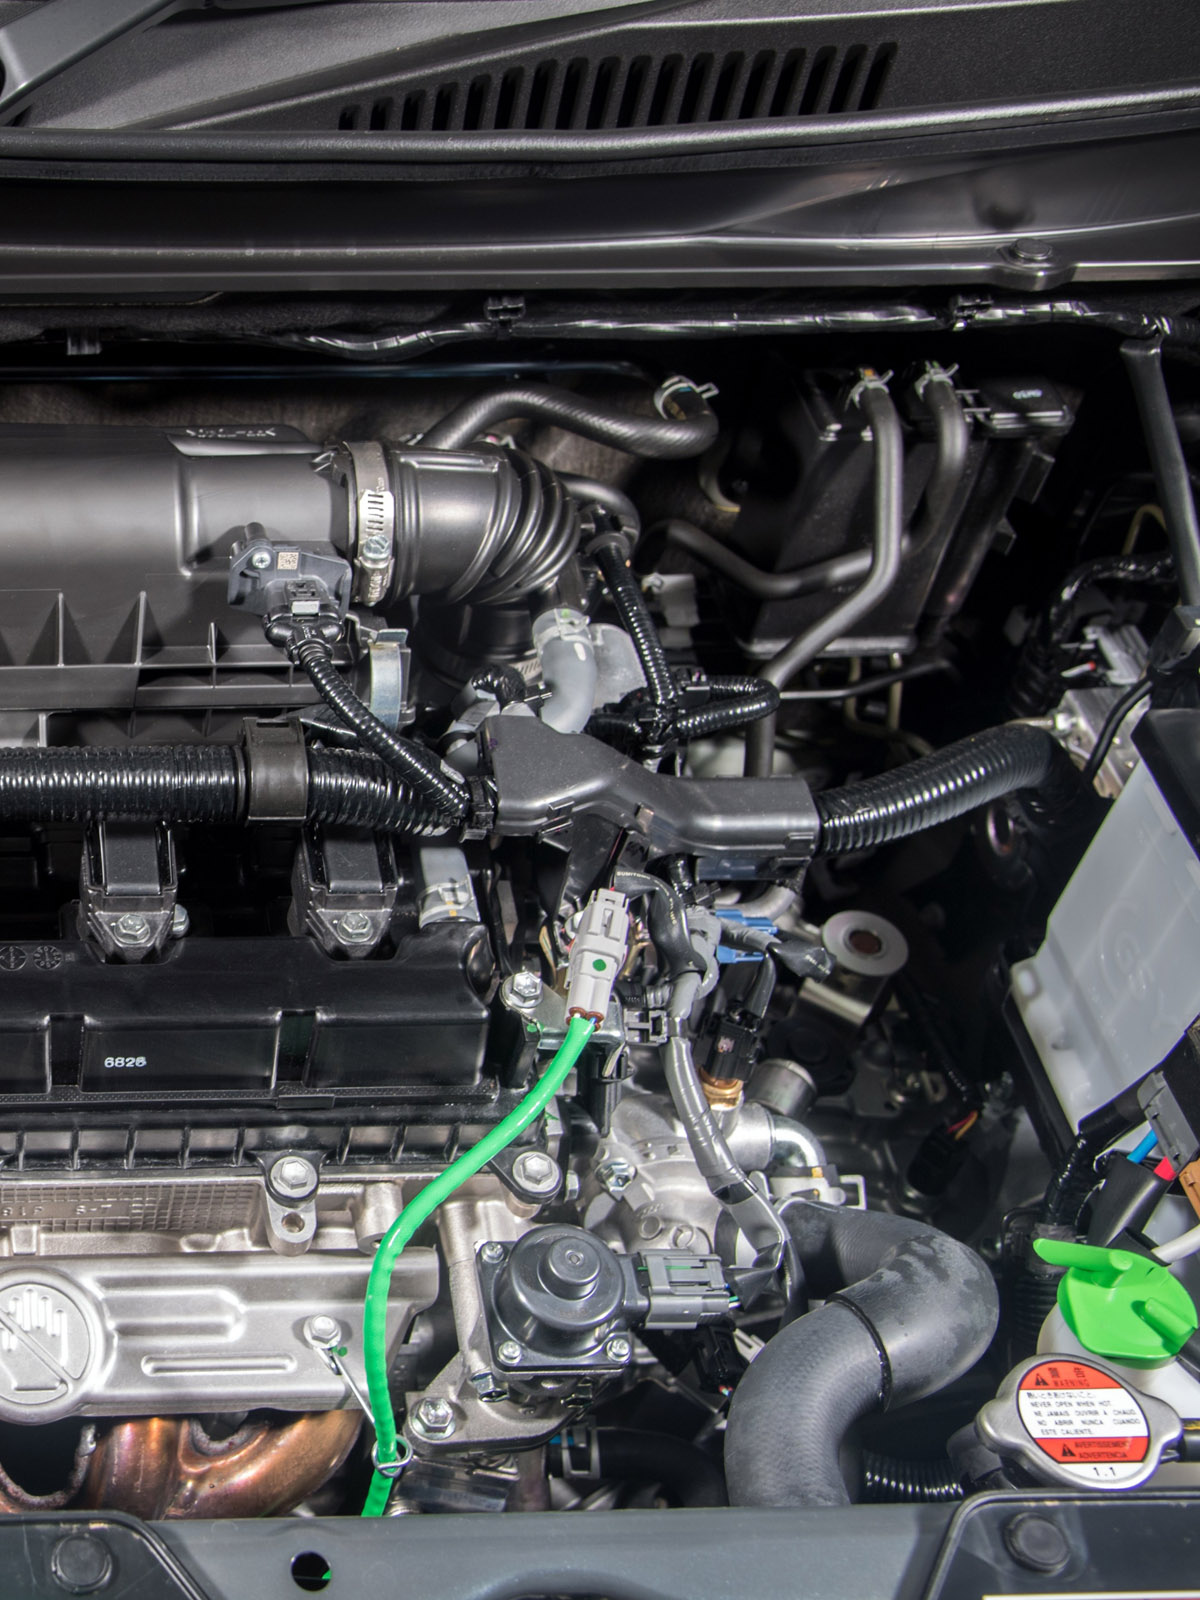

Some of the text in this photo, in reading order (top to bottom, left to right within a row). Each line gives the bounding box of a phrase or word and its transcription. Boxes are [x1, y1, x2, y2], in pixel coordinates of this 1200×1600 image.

[1054, 1379, 1090, 1387] WARNING
[1079, 1451, 1128, 1459] ADVERTENCIA
[1093, 1467, 1116, 1476] 1.1
